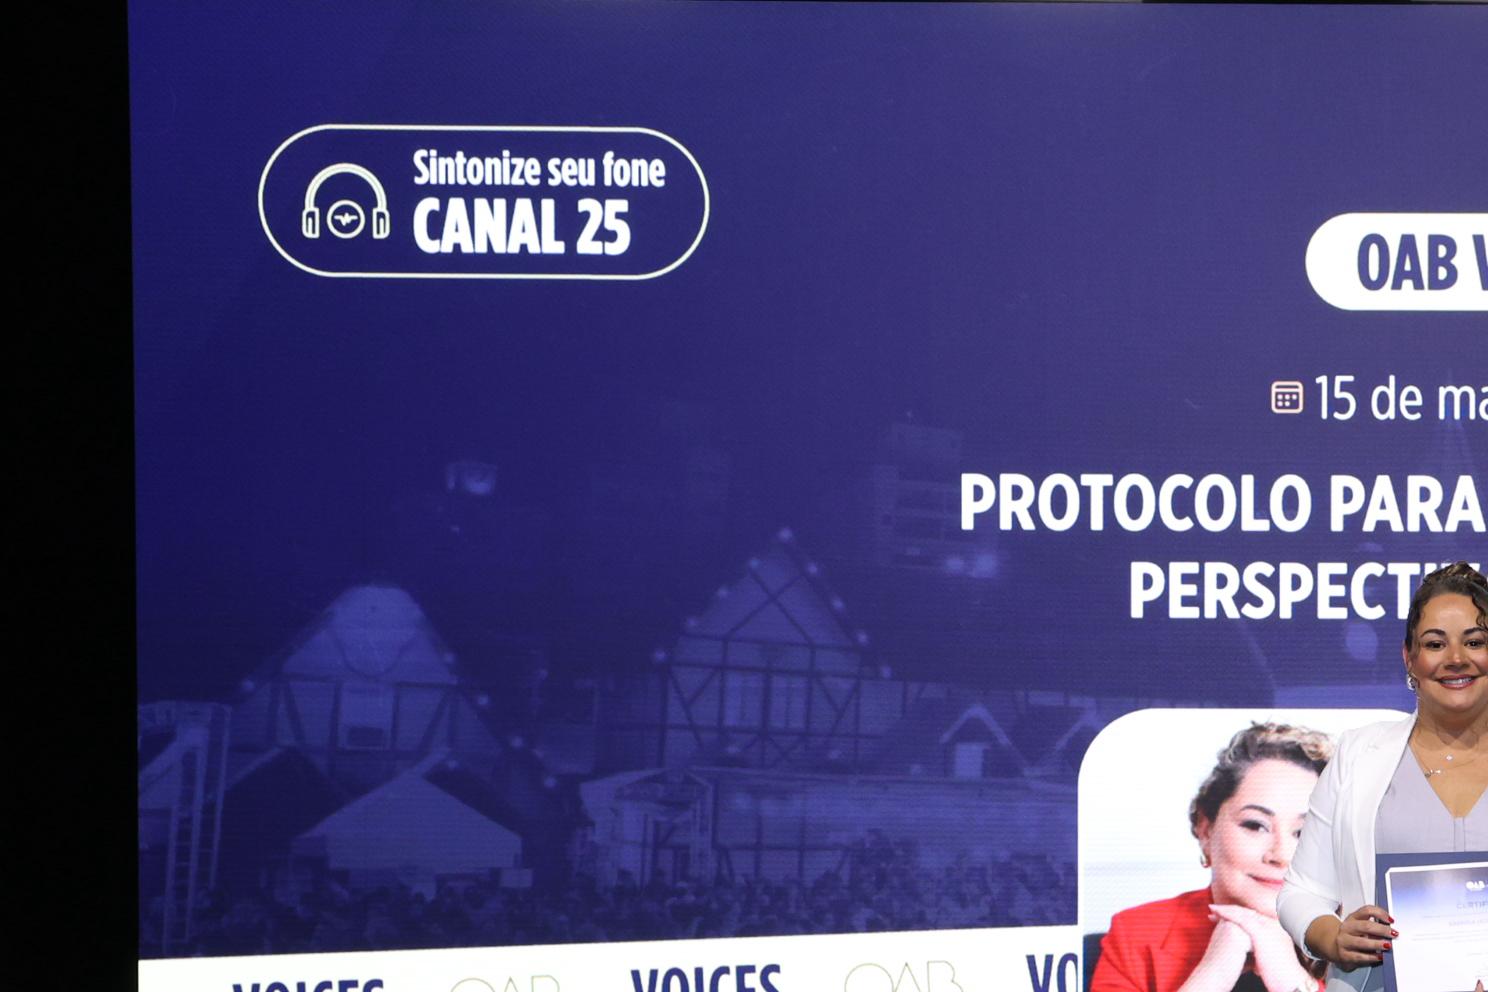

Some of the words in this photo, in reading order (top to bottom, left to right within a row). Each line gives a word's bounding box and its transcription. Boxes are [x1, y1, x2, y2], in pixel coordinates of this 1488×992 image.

[413, 149, 541, 186] Sintonize
[547, 157, 596, 187] seu
[602, 150, 666, 188] fone
[413, 197, 565, 254] CANAL
[576, 197, 631, 256] 25
[1357, 233, 1458, 291] OAB
[1315, 374, 1357, 421] 15
[1370, 374, 1423, 421] de
[960, 472, 1312, 533] PROTOCOLO
[1330, 474, 1487, 533] PARA
